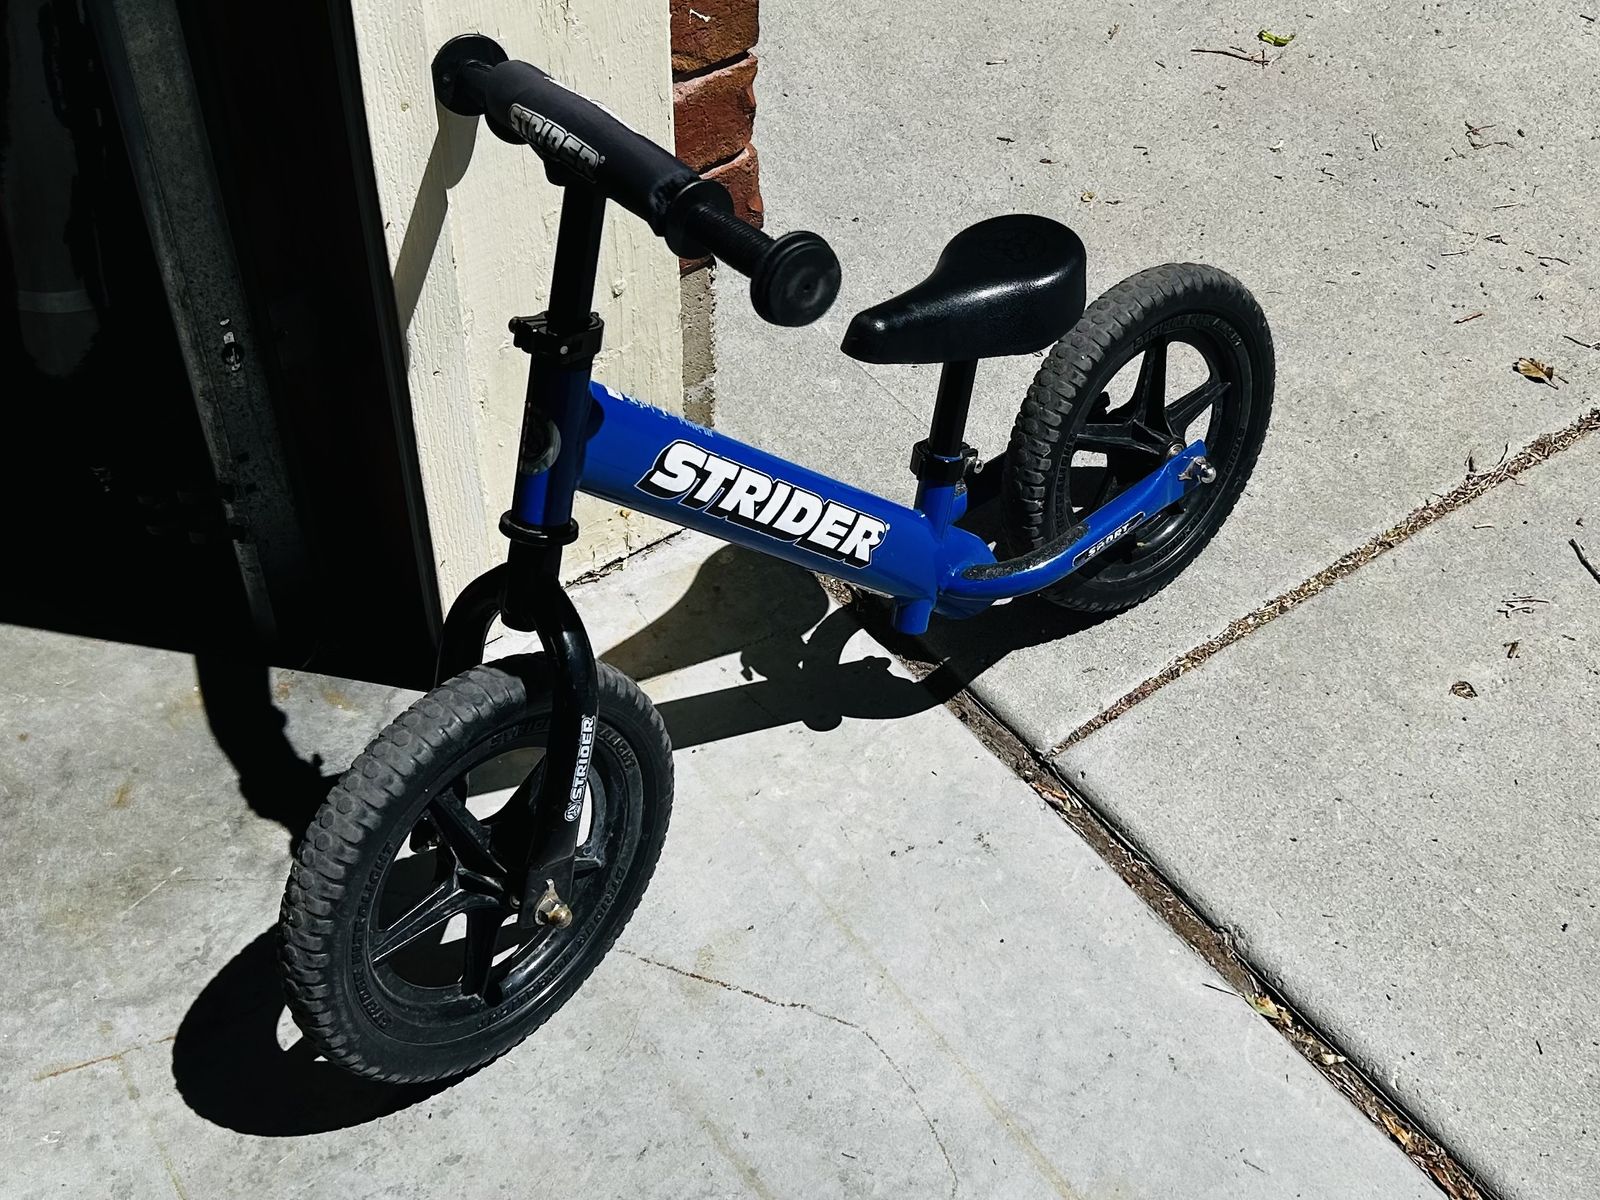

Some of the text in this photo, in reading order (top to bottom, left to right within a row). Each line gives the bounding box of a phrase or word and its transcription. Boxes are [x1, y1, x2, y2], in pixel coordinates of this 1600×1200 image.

[508, 103, 602, 182] STRIDER
[637, 440, 887, 568] STRIDER
[1087, 521, 1133, 557] SPORT
[570, 715, 596, 802] STRIDER
